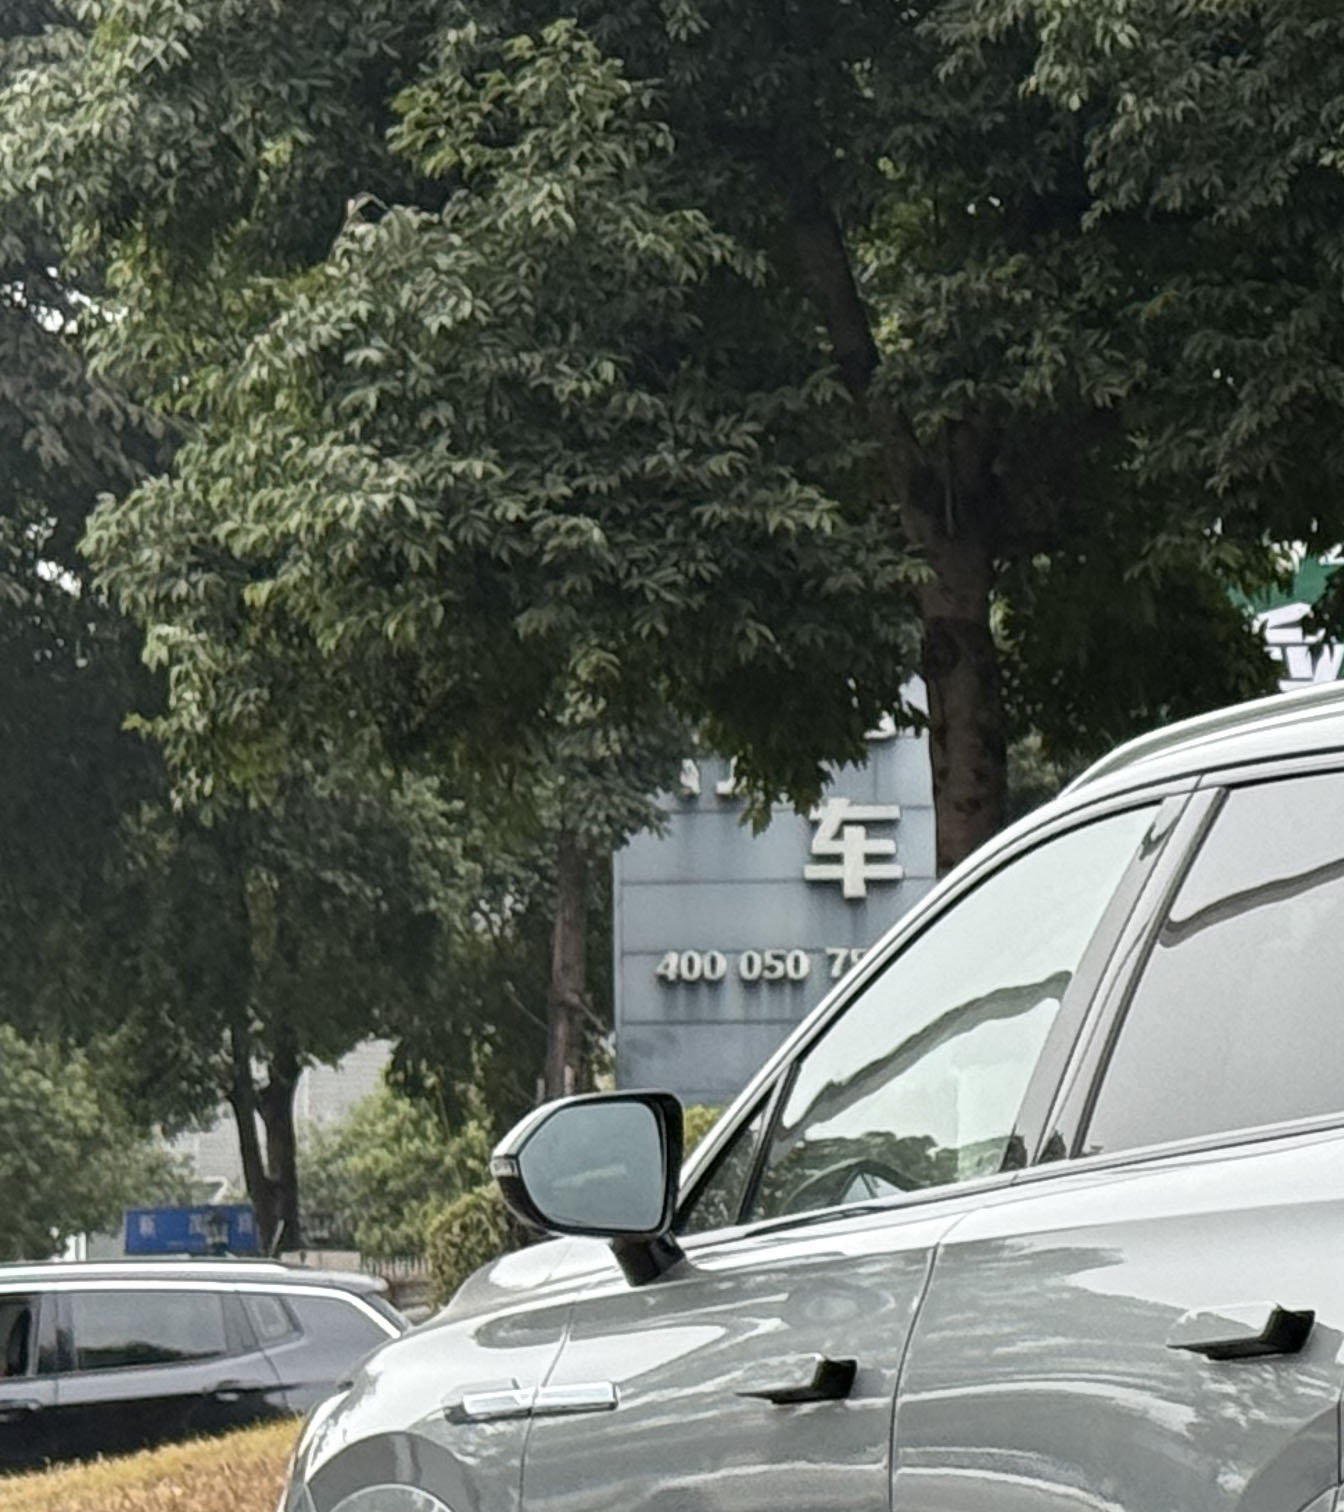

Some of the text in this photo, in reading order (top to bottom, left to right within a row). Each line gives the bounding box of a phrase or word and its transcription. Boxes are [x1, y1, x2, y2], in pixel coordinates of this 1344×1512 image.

[803, 798, 903, 898] 车
[656, 950, 727, 981] 400
[739, 950, 810, 981] 050
